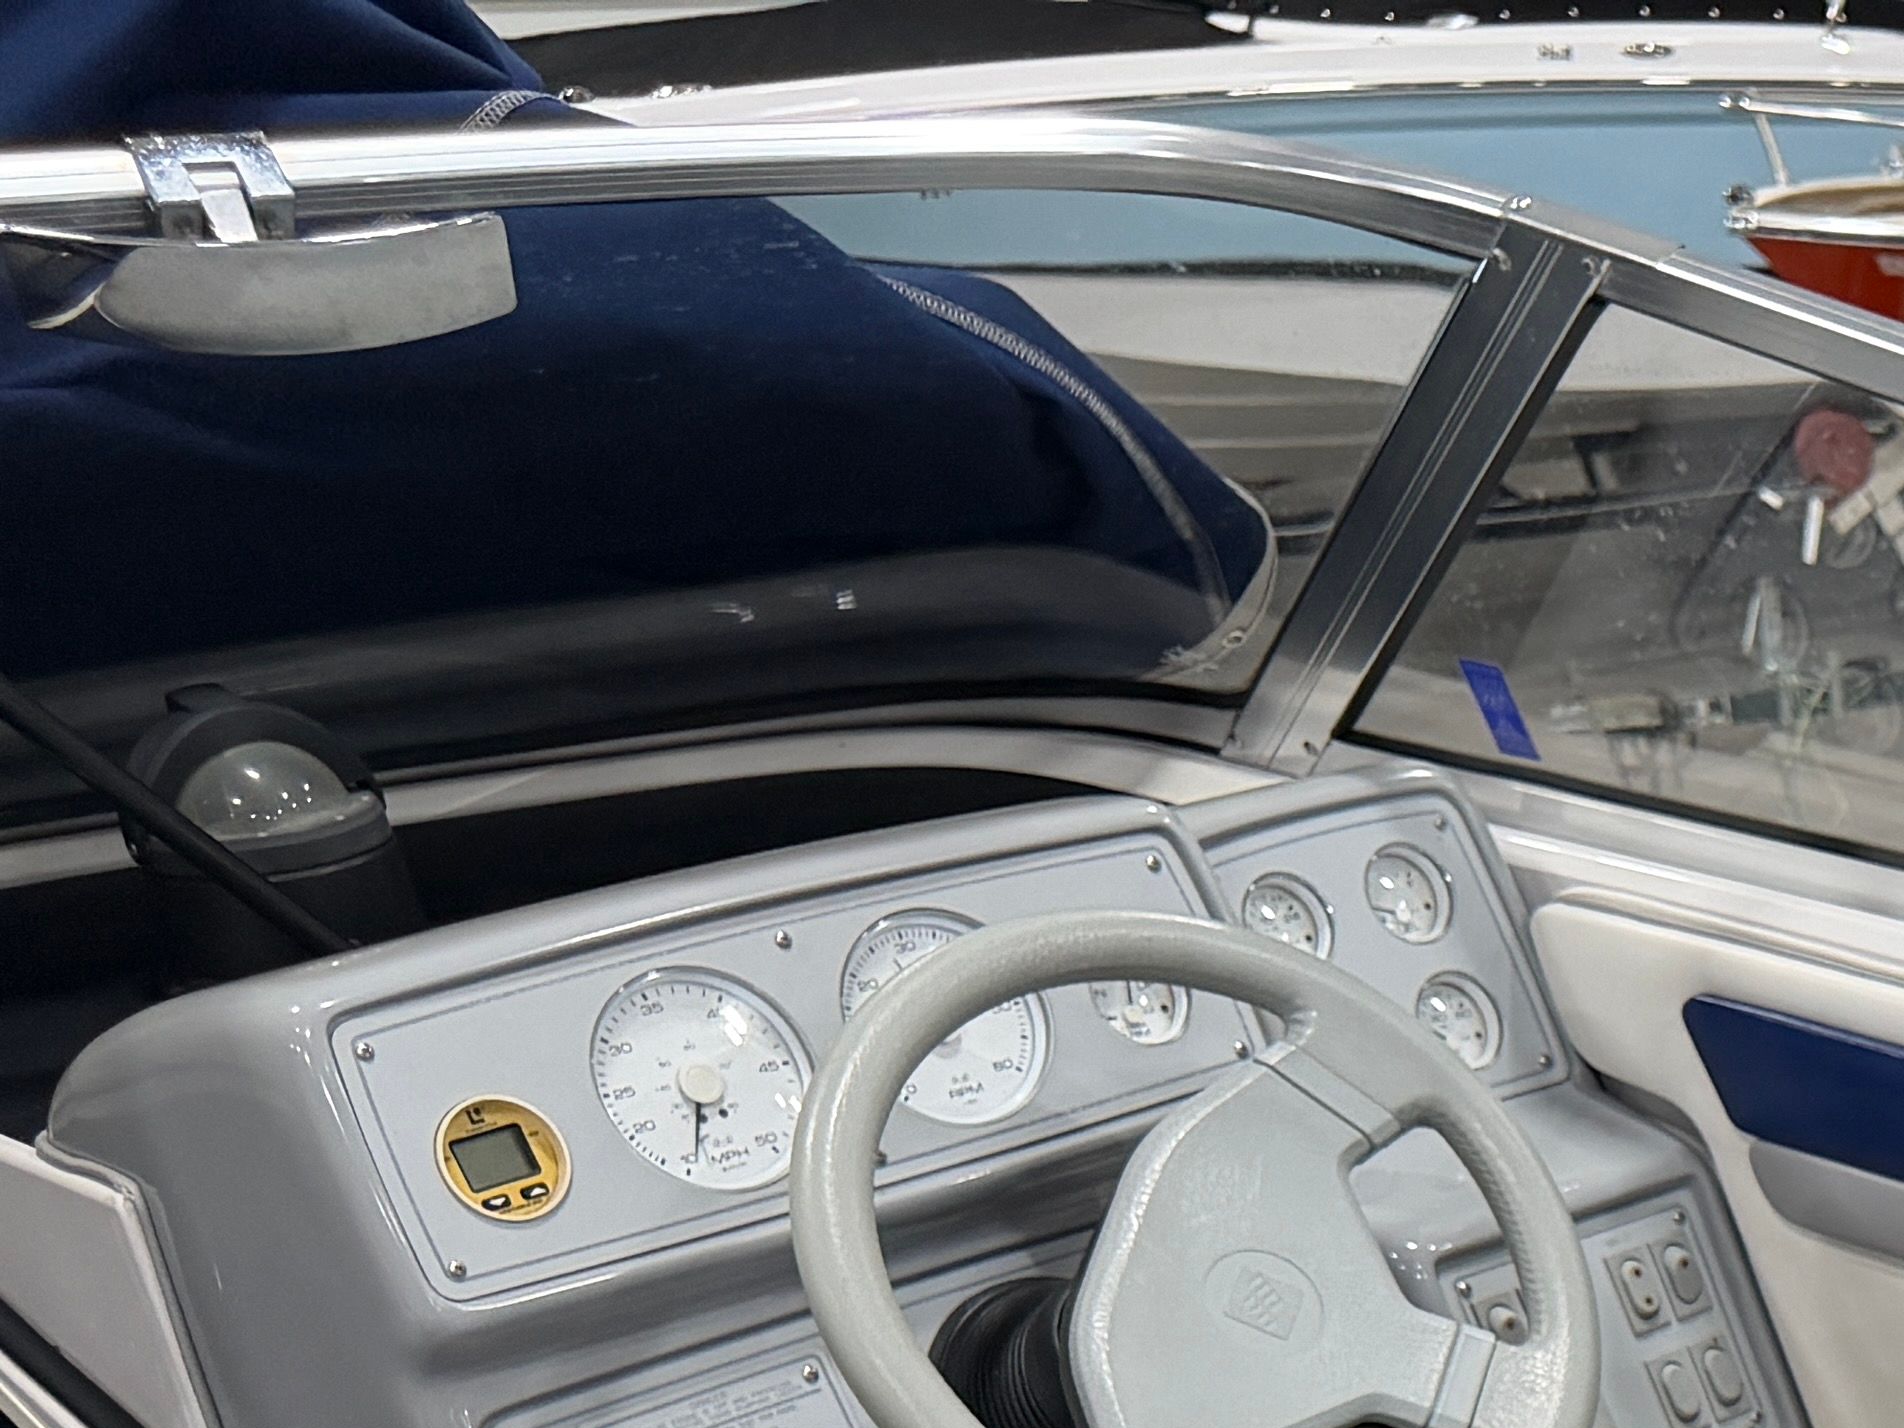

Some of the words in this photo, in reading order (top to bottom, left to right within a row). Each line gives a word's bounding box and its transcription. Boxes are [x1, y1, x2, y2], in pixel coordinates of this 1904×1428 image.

[640, 1002, 664, 1016] 35
[609, 1043, 633, 1057] 30
[758, 1060, 780, 1073] 45
[612, 1086, 636, 1101] 25
[632, 1119, 657, 1134] 20
[754, 1132, 778, 1147] 50
[710, 1146, 750, 1165] MPH
